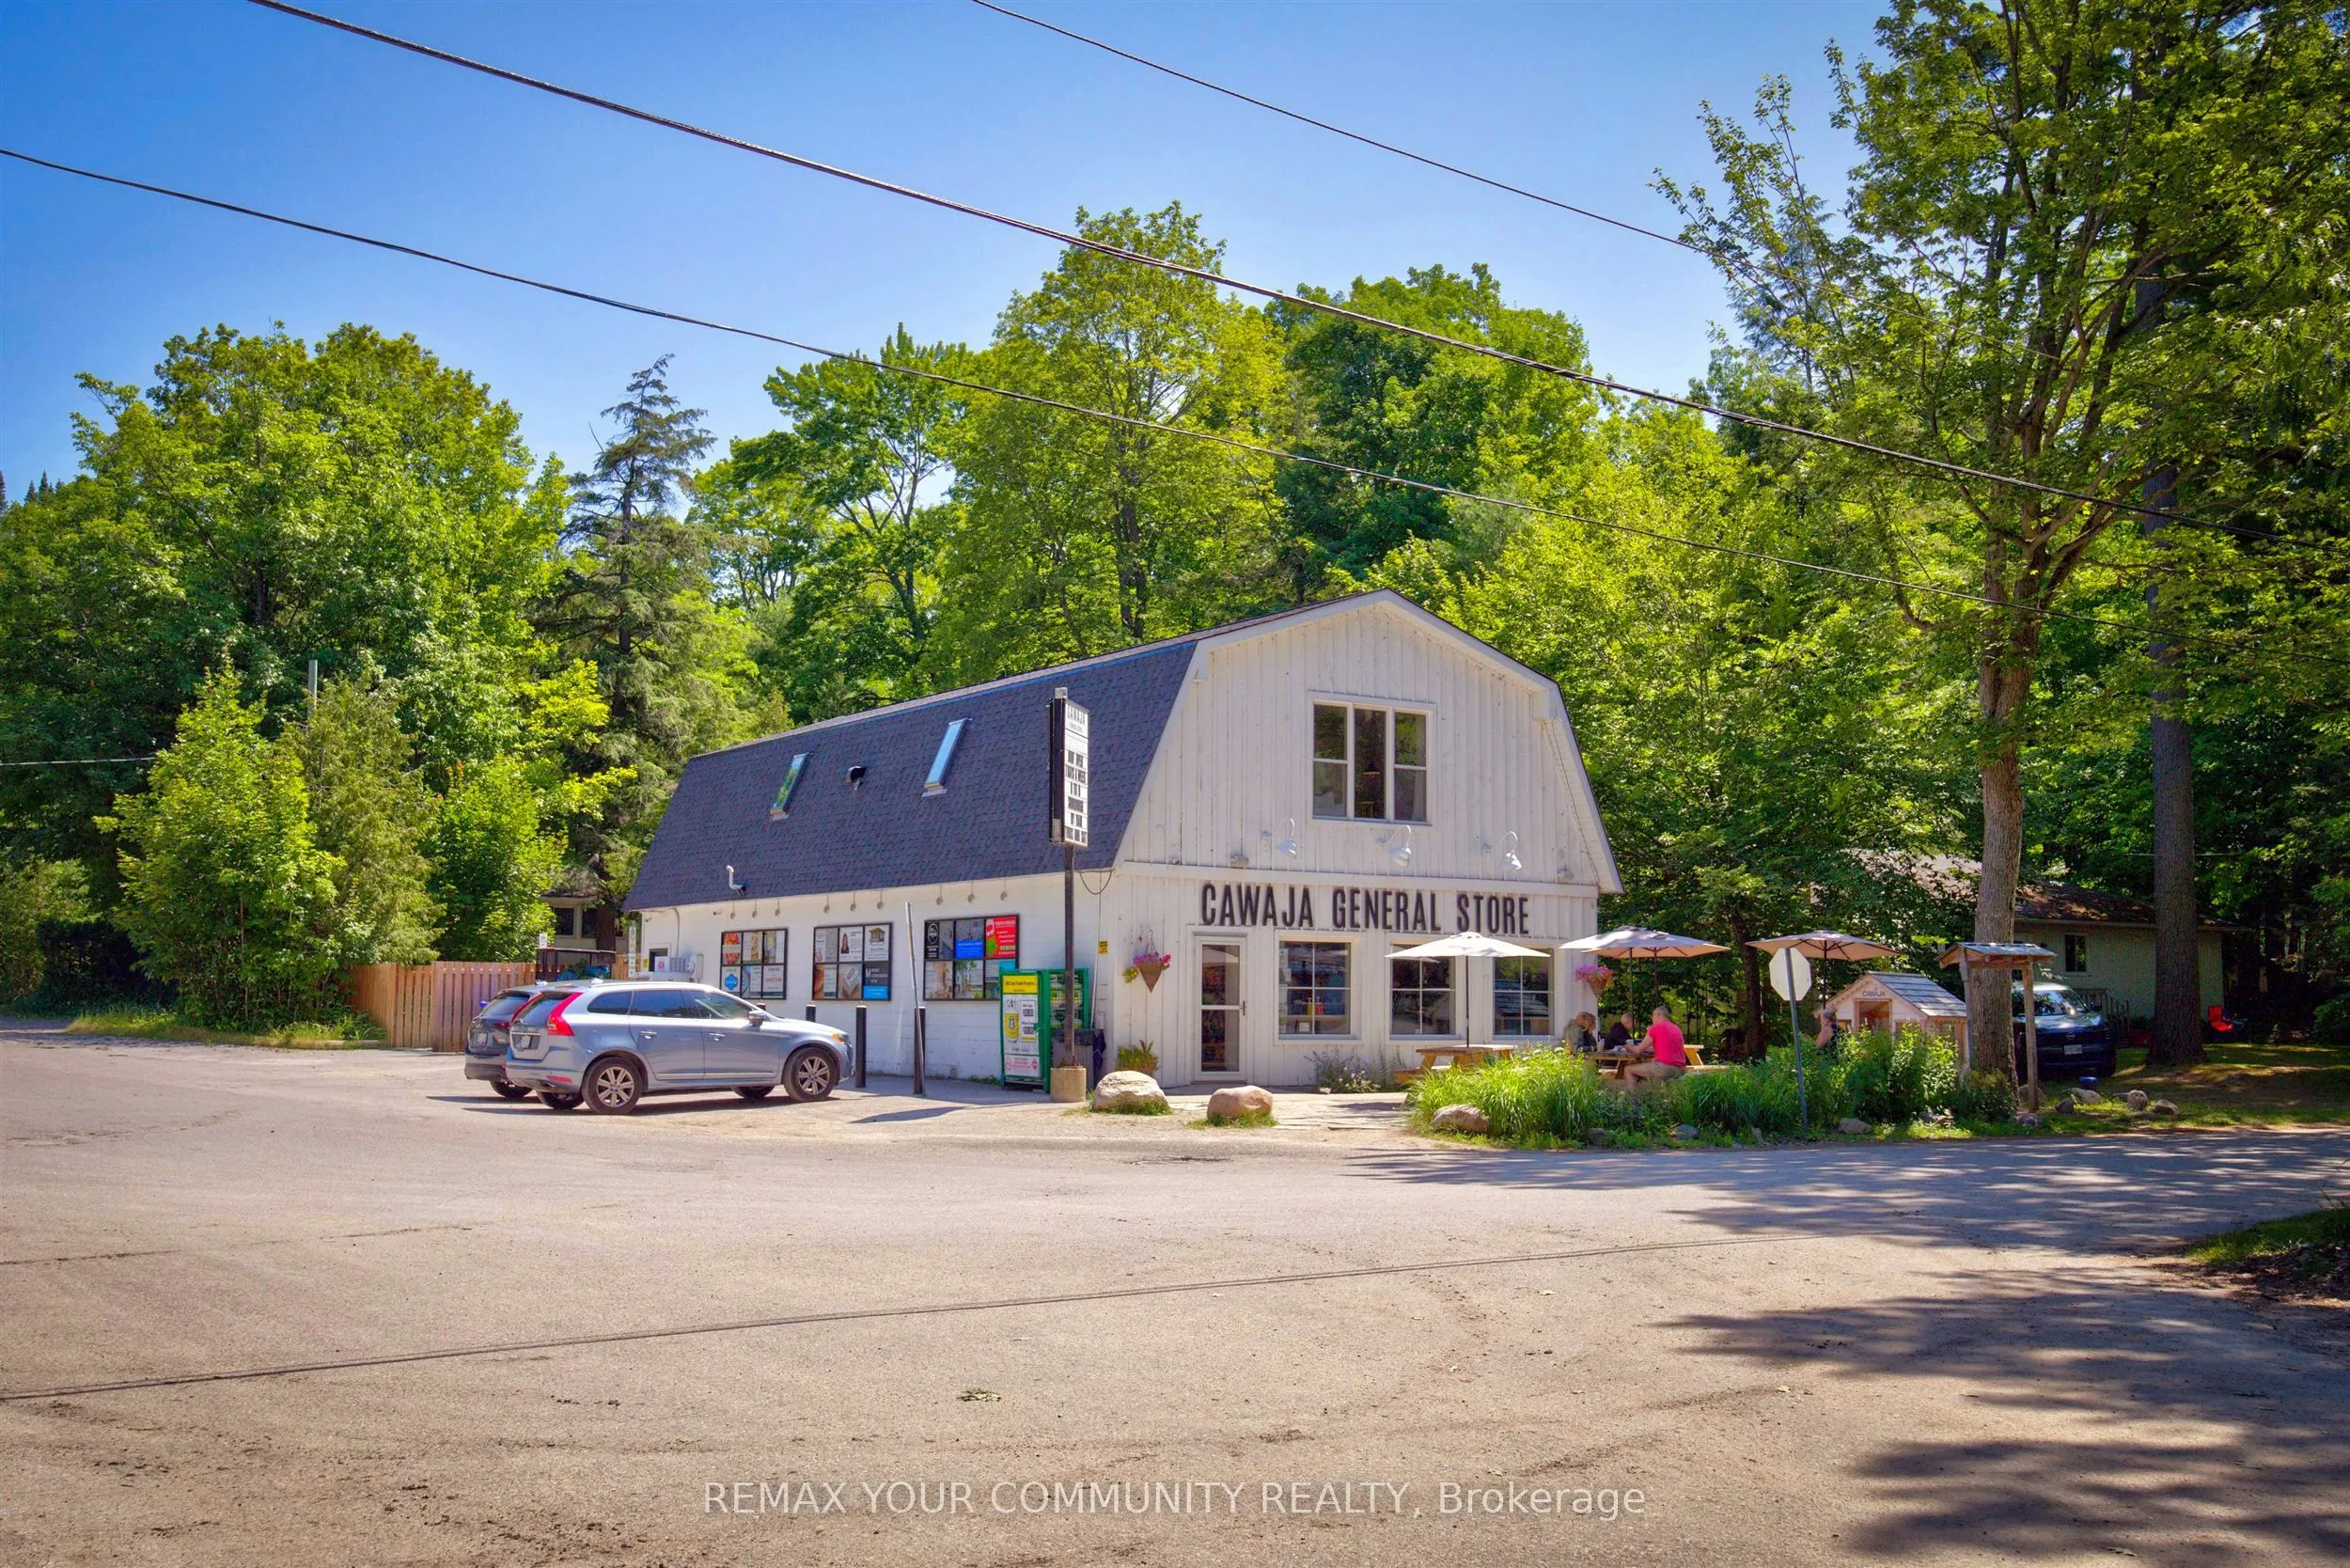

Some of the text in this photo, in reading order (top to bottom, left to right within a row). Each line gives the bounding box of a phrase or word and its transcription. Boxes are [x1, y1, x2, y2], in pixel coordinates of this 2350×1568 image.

[1201, 884, 1529, 934] CAWAJA GENERAL STORE
